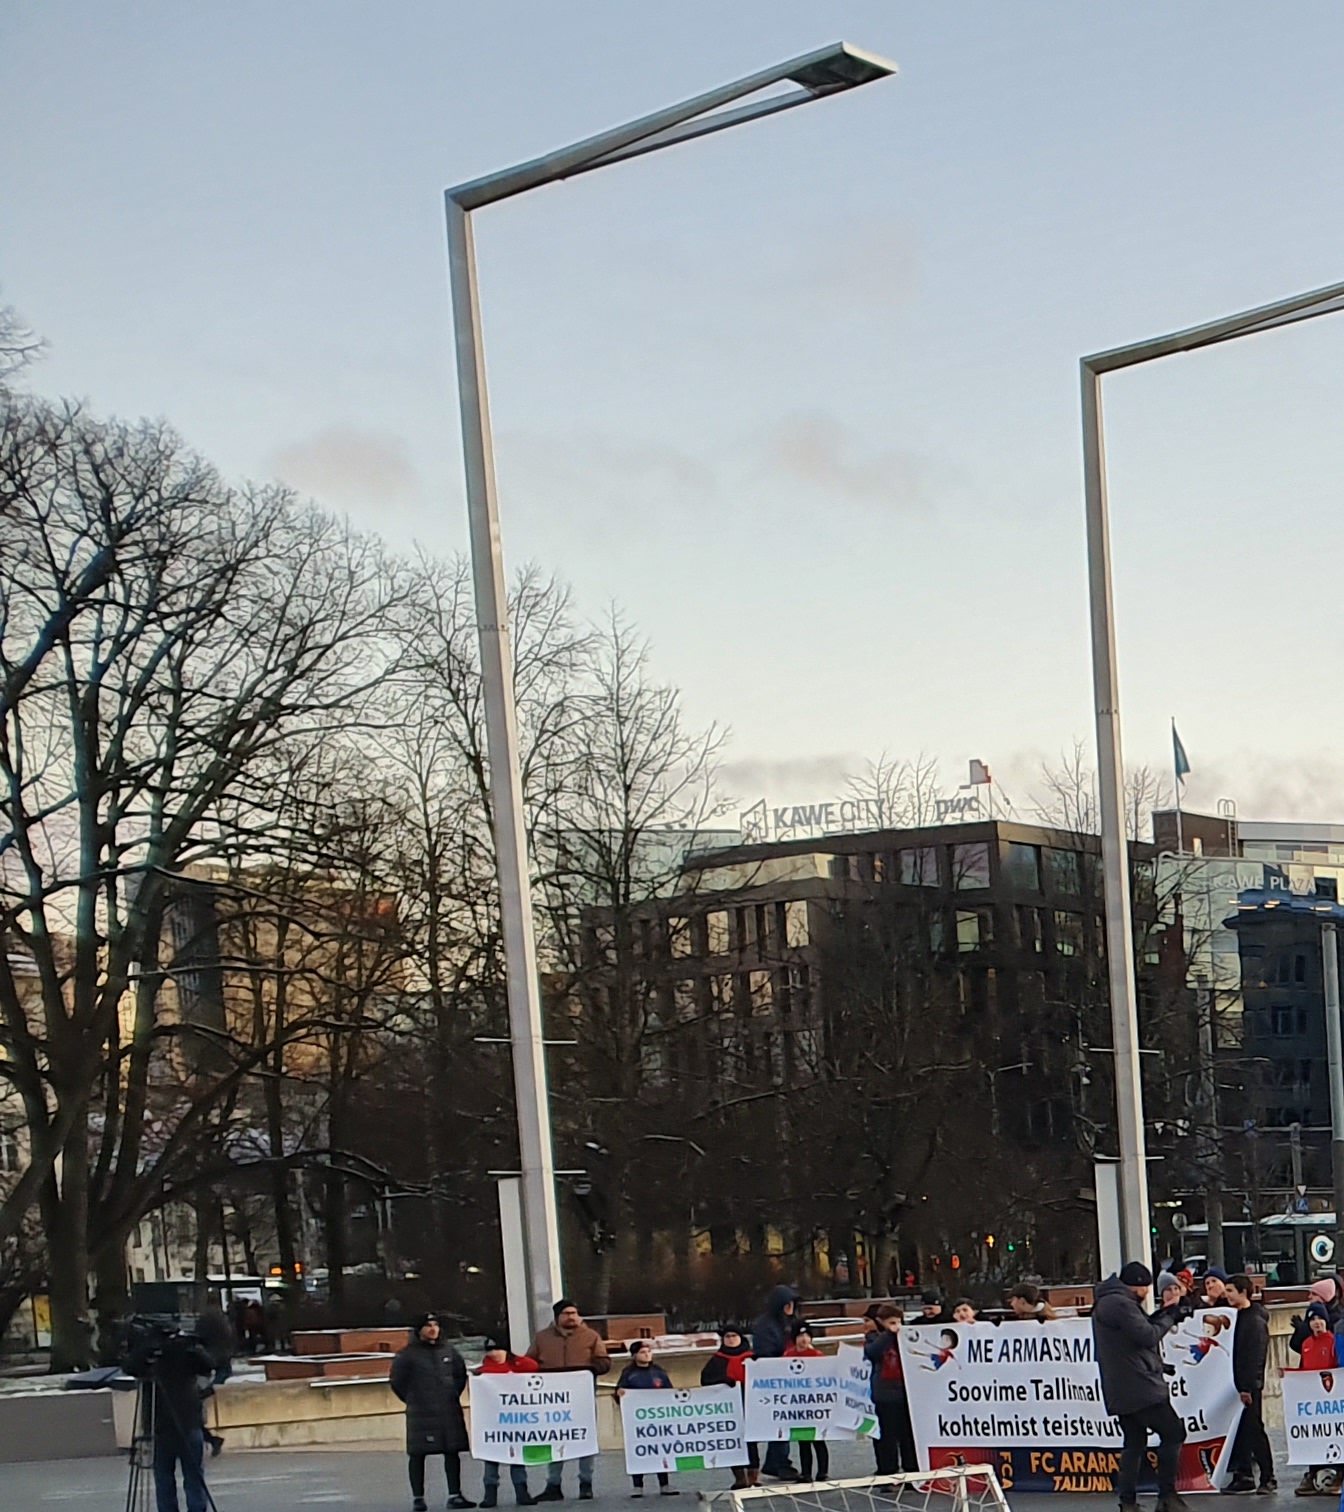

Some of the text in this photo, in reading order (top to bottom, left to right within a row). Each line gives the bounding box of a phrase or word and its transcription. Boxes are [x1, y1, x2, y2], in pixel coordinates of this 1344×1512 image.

[774, 803, 835, 828] KAWE
[1270, 876, 1317, 894] PLAZA
[968, 1339, 993, 1363] ME
[752, 1378, 812, 1389] AMETNIKE
[948, 1380, 1027, 1402] Soovime
[499, 1391, 570, 1405] TALLINN!
[773, 1394, 788, 1404] FC
[499, 1410, 571, 1424] MIKS 10X
[635, 1402, 734, 1420] OSSINOVSKI!
[773, 1409, 831, 1420] PANKROT
[1297, 1402, 1312, 1416] FC
[636, 1420, 736, 1438] KÕIK LAPSED
[938, 1414, 1038, 1437] kohtelmist
[1291, 1424, 1309, 1439] ON
[1313, 1423, 1332, 1438] MU
[484, 1428, 587, 1443] HINNAVAHE?
[635, 1438, 741, 1456] ON VÕRDSED!
[1000, 1452, 1013, 1489] FCA
[1030, 1452, 1056, 1473] FC
[1053, 1476, 1113, 1491] TALLINN
